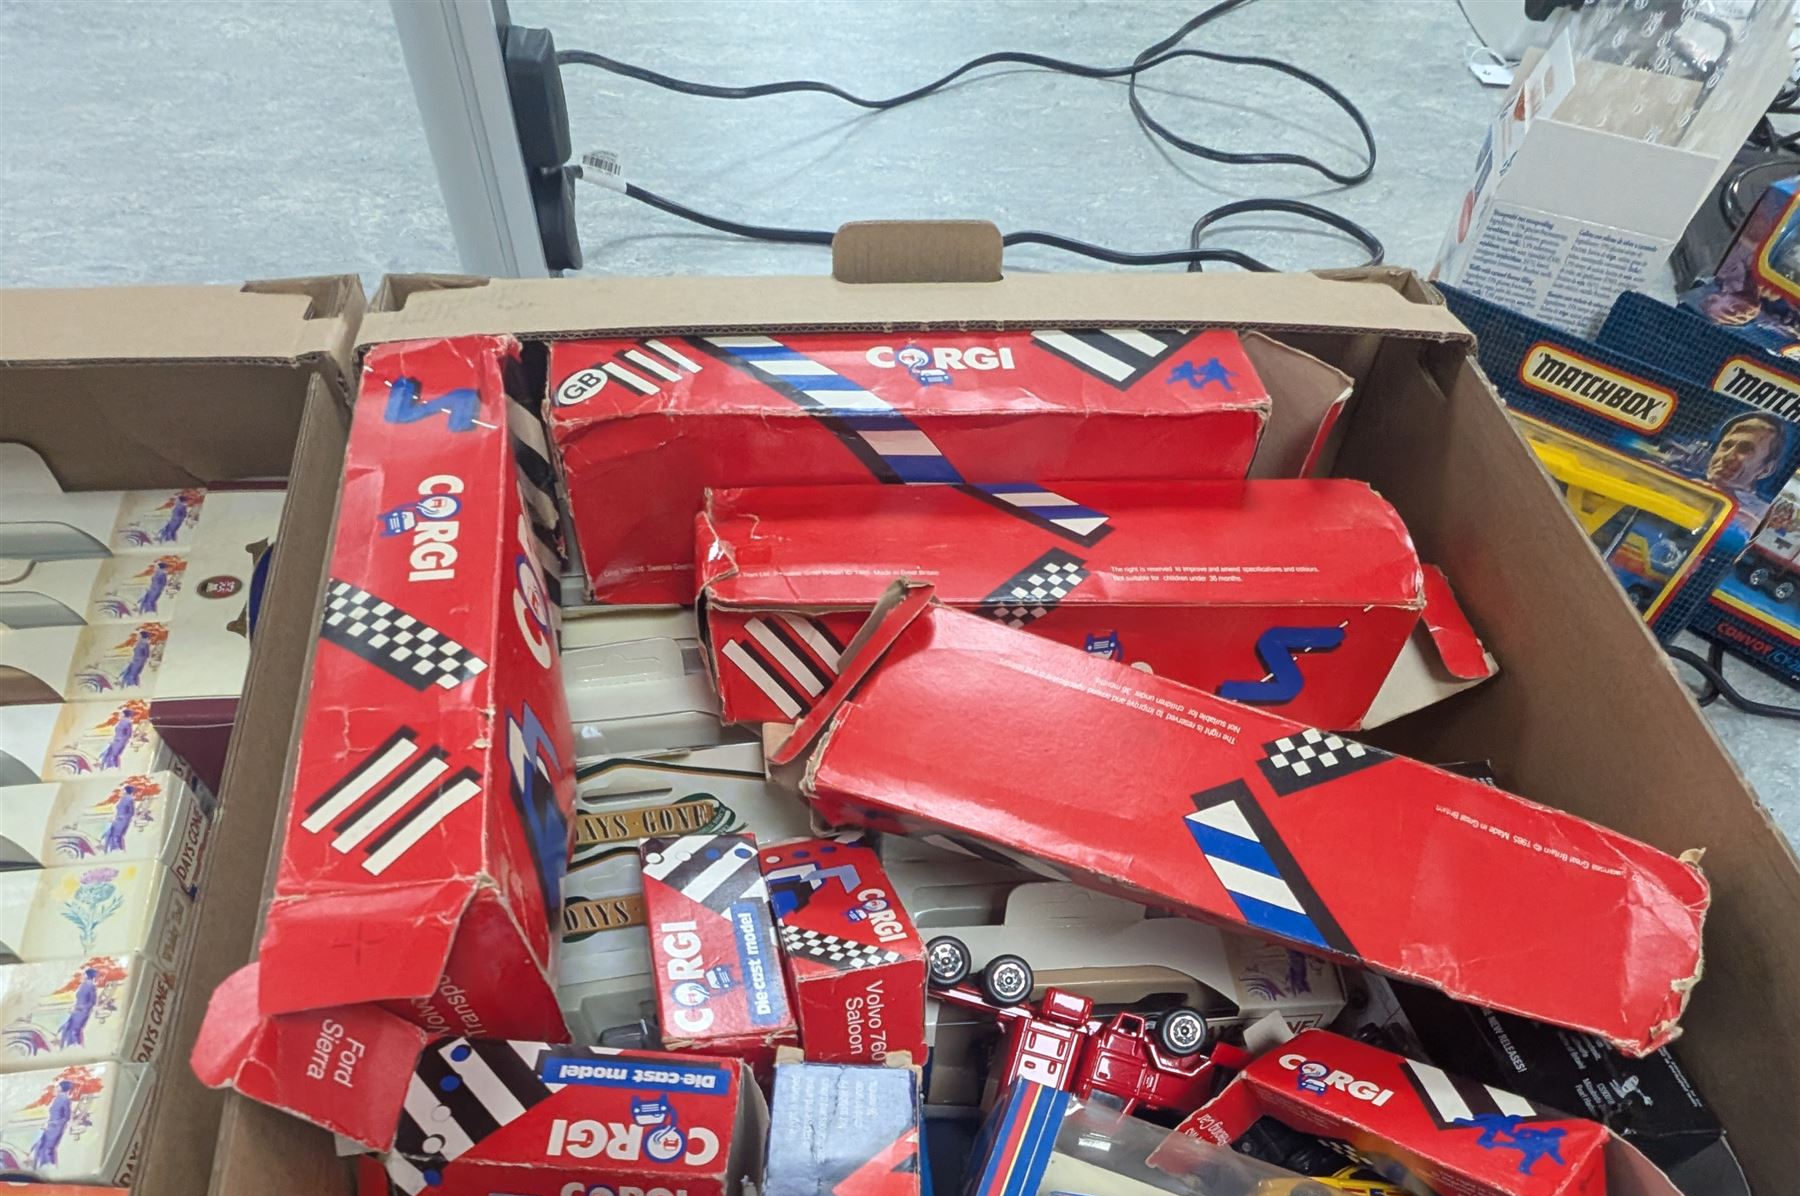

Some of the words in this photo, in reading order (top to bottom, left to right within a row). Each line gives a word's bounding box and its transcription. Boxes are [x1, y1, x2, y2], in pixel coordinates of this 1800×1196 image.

[865, 345, 1014, 371] CORGI
[563, 367, 603, 400] GB
[408, 474, 464, 582] CORGI
[177, 843, 195, 880] DAYS
[188, 806, 204, 845] GONE
[576, 814, 629, 842] AYS
[642, 804, 709, 833] GONE
[1488, 825, 1510, 841] Made
[564, 902, 631, 931] DAYS
[738, 913, 757, 955] model
[857, 888, 908, 943] CORGI
[661, 920, 714, 1033] CORGI
[845, 997, 864, 1055] Saloon
[866, 980, 885, 1029] Volvo
[137, 1025, 157, 1063] DAYS
[306, 1019, 344, 1080] Sierra
[334, 1037, 365, 1088] Ford
[868, 1030, 887, 1062] 760
[1498, 1033, 1528, 1073] RELEASES!
[559, 1064, 628, 1081] model
[1279, 1054, 1395, 1107] CORGI
[546, 1119, 720, 1166] CORGI
[1197, 1114, 1215, 1130] Car
[119, 1141, 139, 1188] DAY
